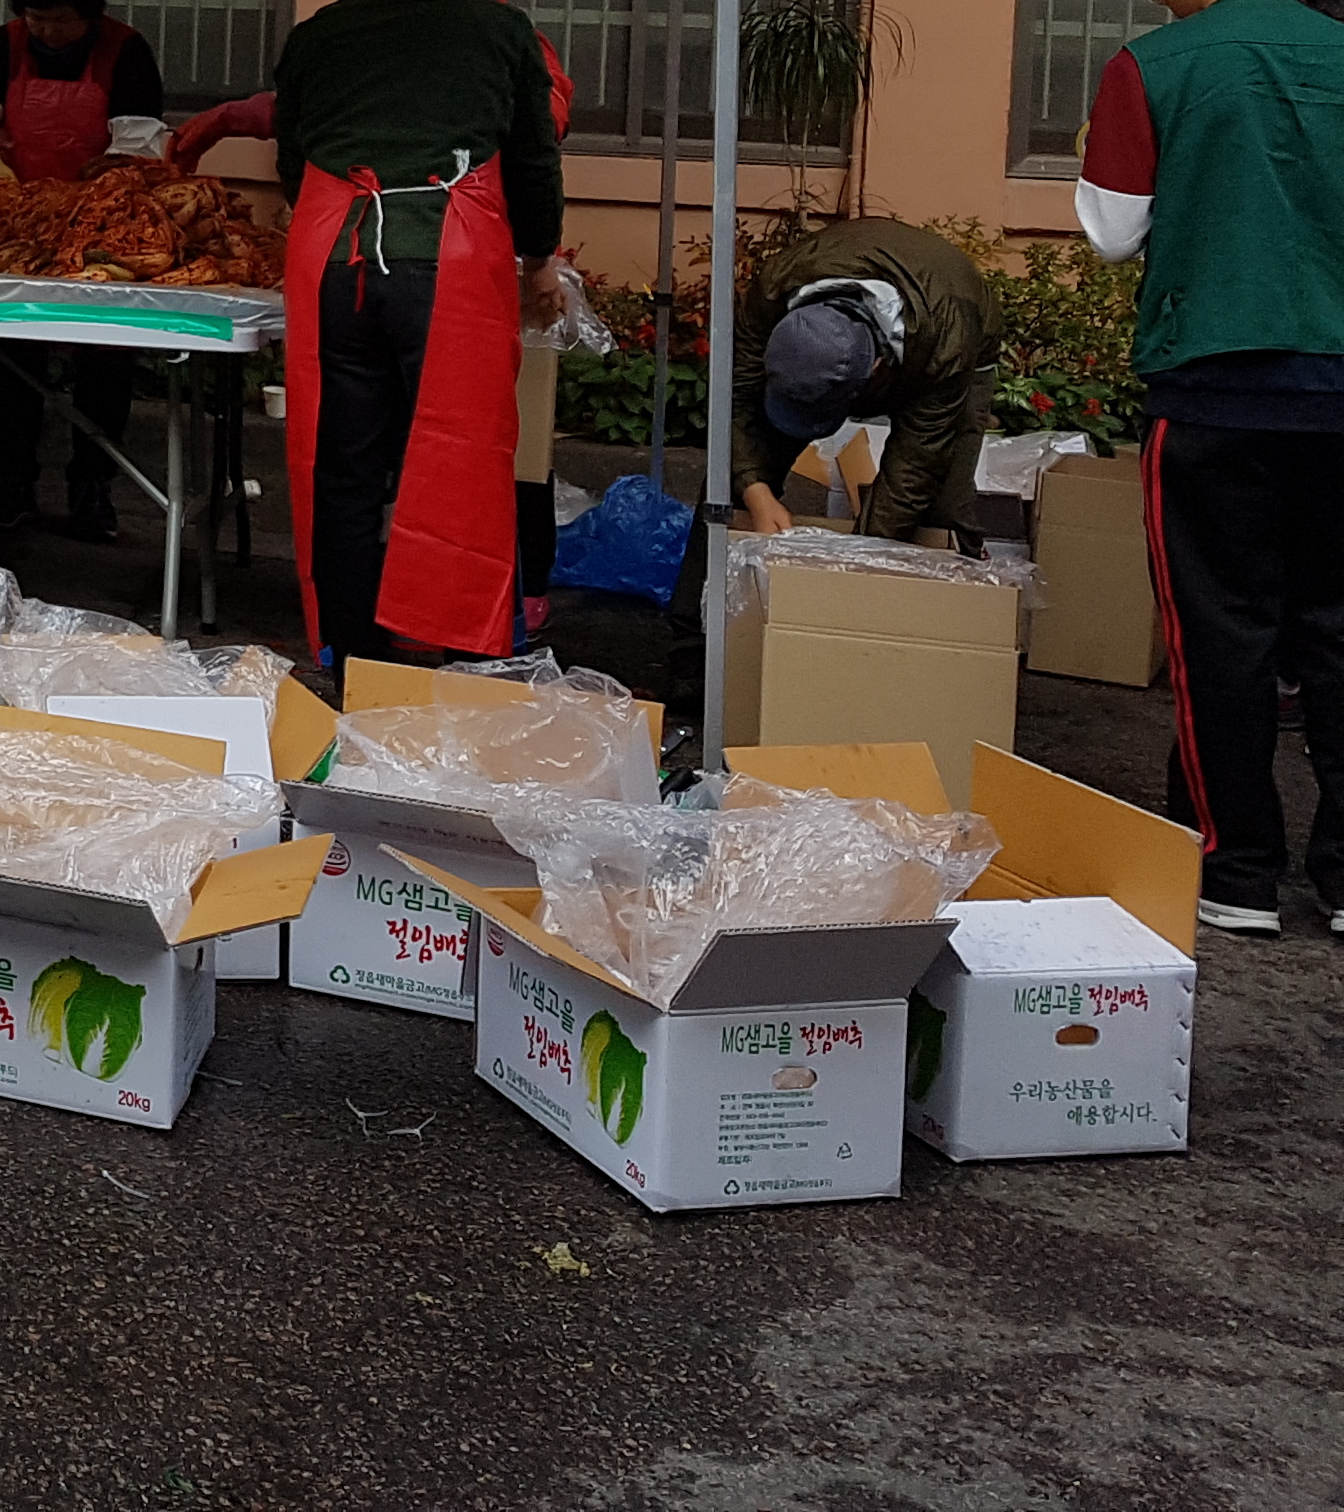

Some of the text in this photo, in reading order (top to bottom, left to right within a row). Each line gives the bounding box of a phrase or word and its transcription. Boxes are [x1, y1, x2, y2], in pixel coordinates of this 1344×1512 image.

[1012, 982, 1149, 1017] MG샘고을 절임배추
[720, 1019, 863, 1057] MG샘고을 절임배추
[117, 1089, 152, 1113] 20kg
